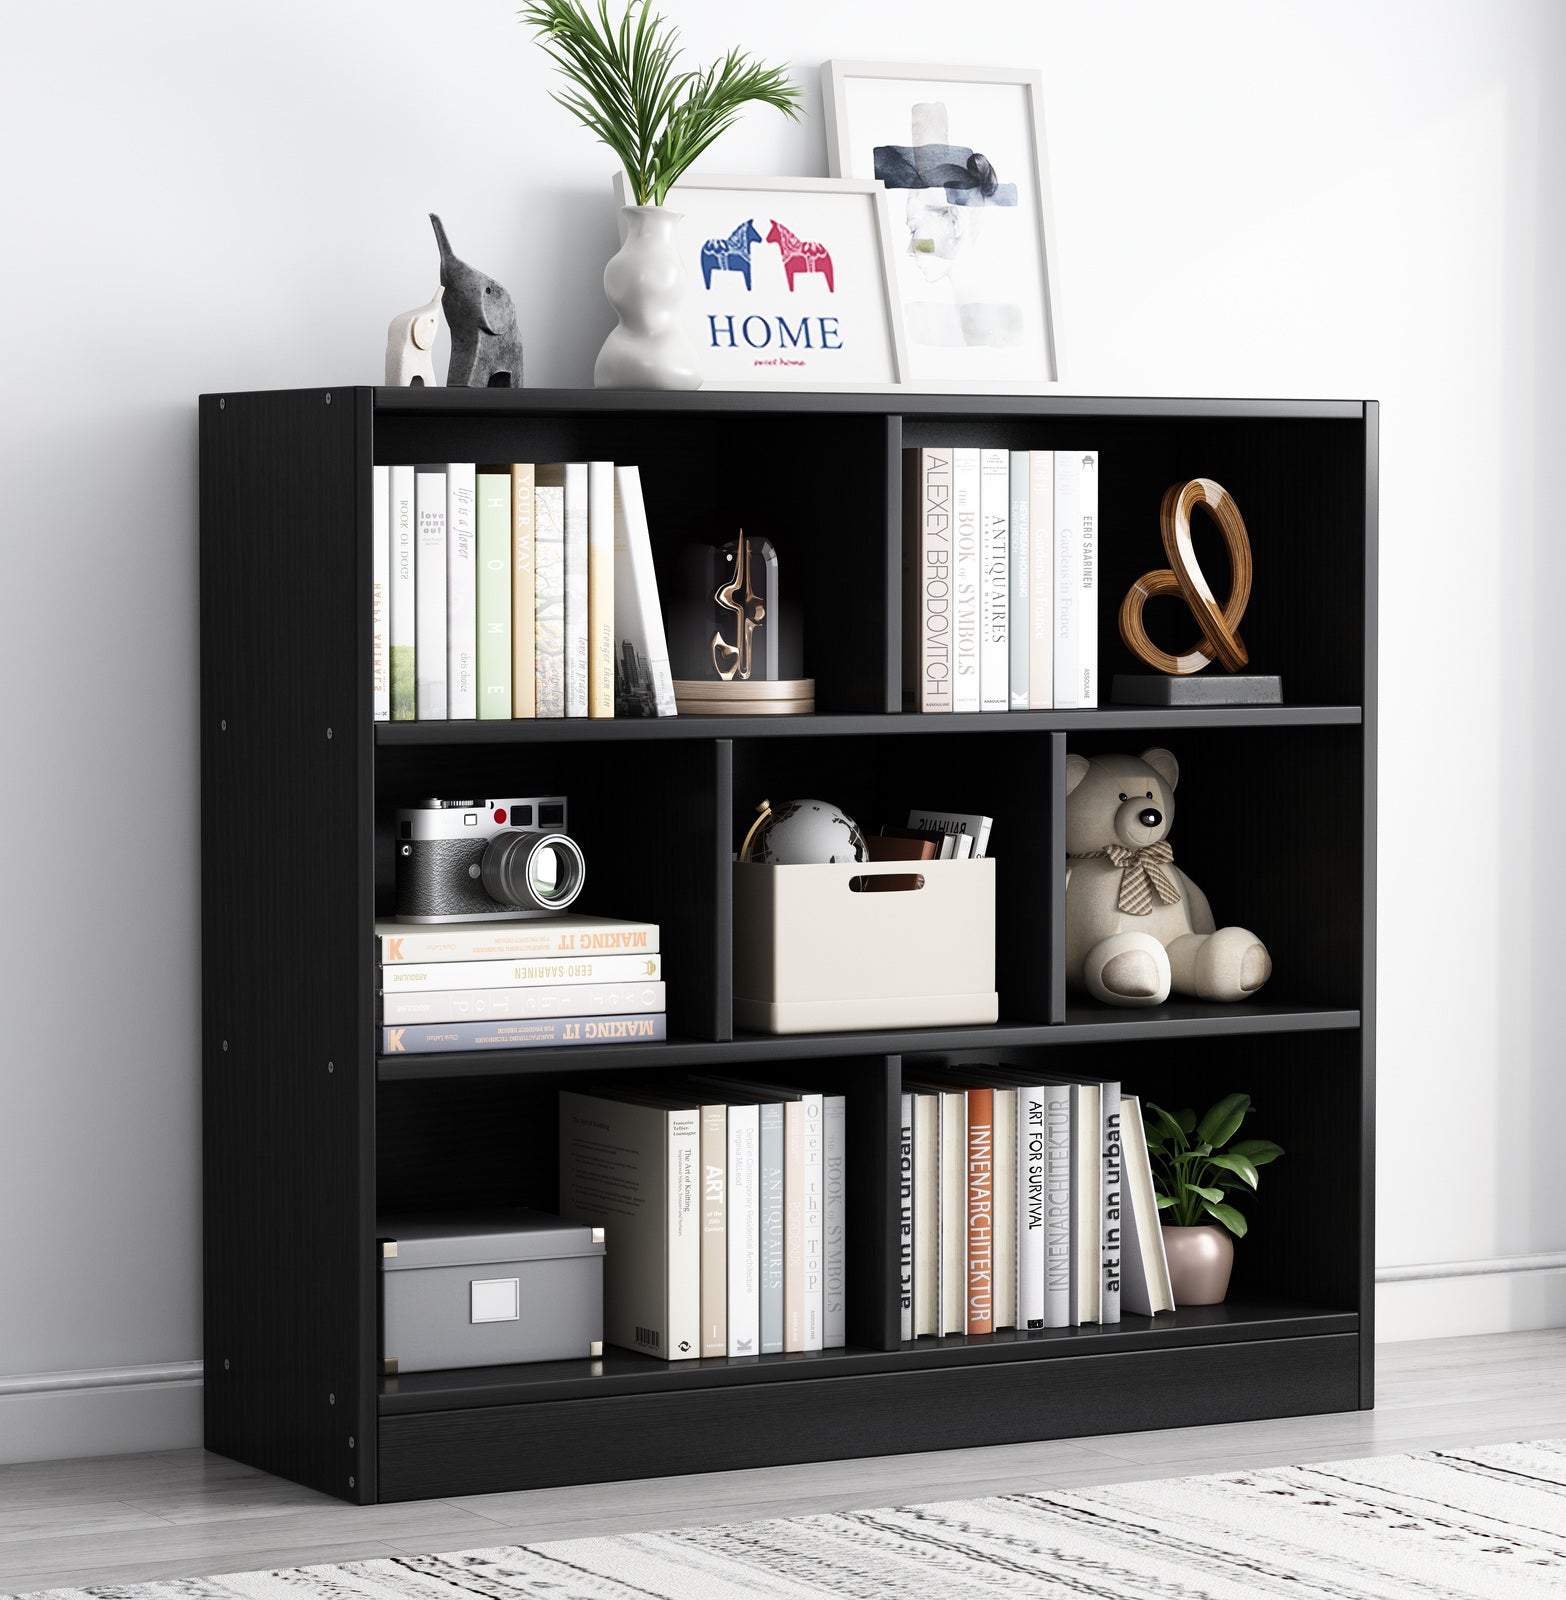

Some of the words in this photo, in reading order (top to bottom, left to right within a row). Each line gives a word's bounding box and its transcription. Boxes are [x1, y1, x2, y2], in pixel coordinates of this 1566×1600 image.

[707, 315, 843, 349] HOME
[453, 488, 473, 504] life
[518, 475, 530, 527] YOUR
[927, 455, 949, 542] ALEXEY
[421, 511, 444, 519] love
[458, 507, 471, 516] is
[458, 519, 469, 527] a
[958, 512, 975, 563] BOOK
[1083, 516, 1093, 539] EERO
[453, 527, 474, 560] flower
[518, 535, 530, 573] WAY
[1060, 528, 1072, 579] Gardens
[989, 515, 1006, 643] ANTIQUAIRES
[1083, 542, 1093, 589] SAARINEN
[487, 498, 505, 694] HOME
[1060, 582, 1072, 594] in
[927, 551, 949, 695] BRODOVITCH
[958, 583, 975, 675] SYMBOLS
[1060, 598, 1073, 639] France
[579, 637, 588, 656] love
[600, 624, 611, 663] stronger
[460, 652, 471, 669] chris
[578, 660, 587, 670] in
[460, 670, 471, 693] choice
[575, 672, 586, 706] prague
[603, 667, 614, 690] than
[603, 693, 611, 707] sin
[558, 934, 576, 950] IT
[580, 931, 647, 949] MAKING
[393, 974, 427, 982] ASSOULINE
[515, 965, 564, 979] SAARINEN
[568, 964, 593, 977] EERO
[562, 1023, 580, 1040] IT
[585, 1020, 654, 1039] MAKING
[1029, 1100, 1043, 1127] ART
[734, 1129, 743, 1156] Virginia
[807, 1104, 819, 1162] Over
[1029, 1132, 1043, 1162] FOR
[684, 1149, 692, 1162] The
[1102, 1113, 1121, 1185] urban
[684, 1163, 692, 1175] Art
[684, 1175, 692, 1184] of
[735, 1157, 743, 1186] McLeod
[827, 1156, 842, 1205] BOOK
[683, 1184, 692, 1213] Knitting
[706, 1165, 723, 1204] ART
[1029, 1166, 1042, 1230] SURVIVAL
[1048, 1100, 1069, 1292] INNENARCHITEKTUR
[809, 1182, 817, 1224] the
[1107, 1192, 1120, 1220] an
[767, 1168, 782, 1289] ANTIQUAIRES
[969, 1125, 992, 1322] INNENARCHITEKTUR
[1102, 1227, 1120, 1250] in
[827, 1225, 842, 1313] SYMBOLS
[1103, 1261, 1120, 1292] art
